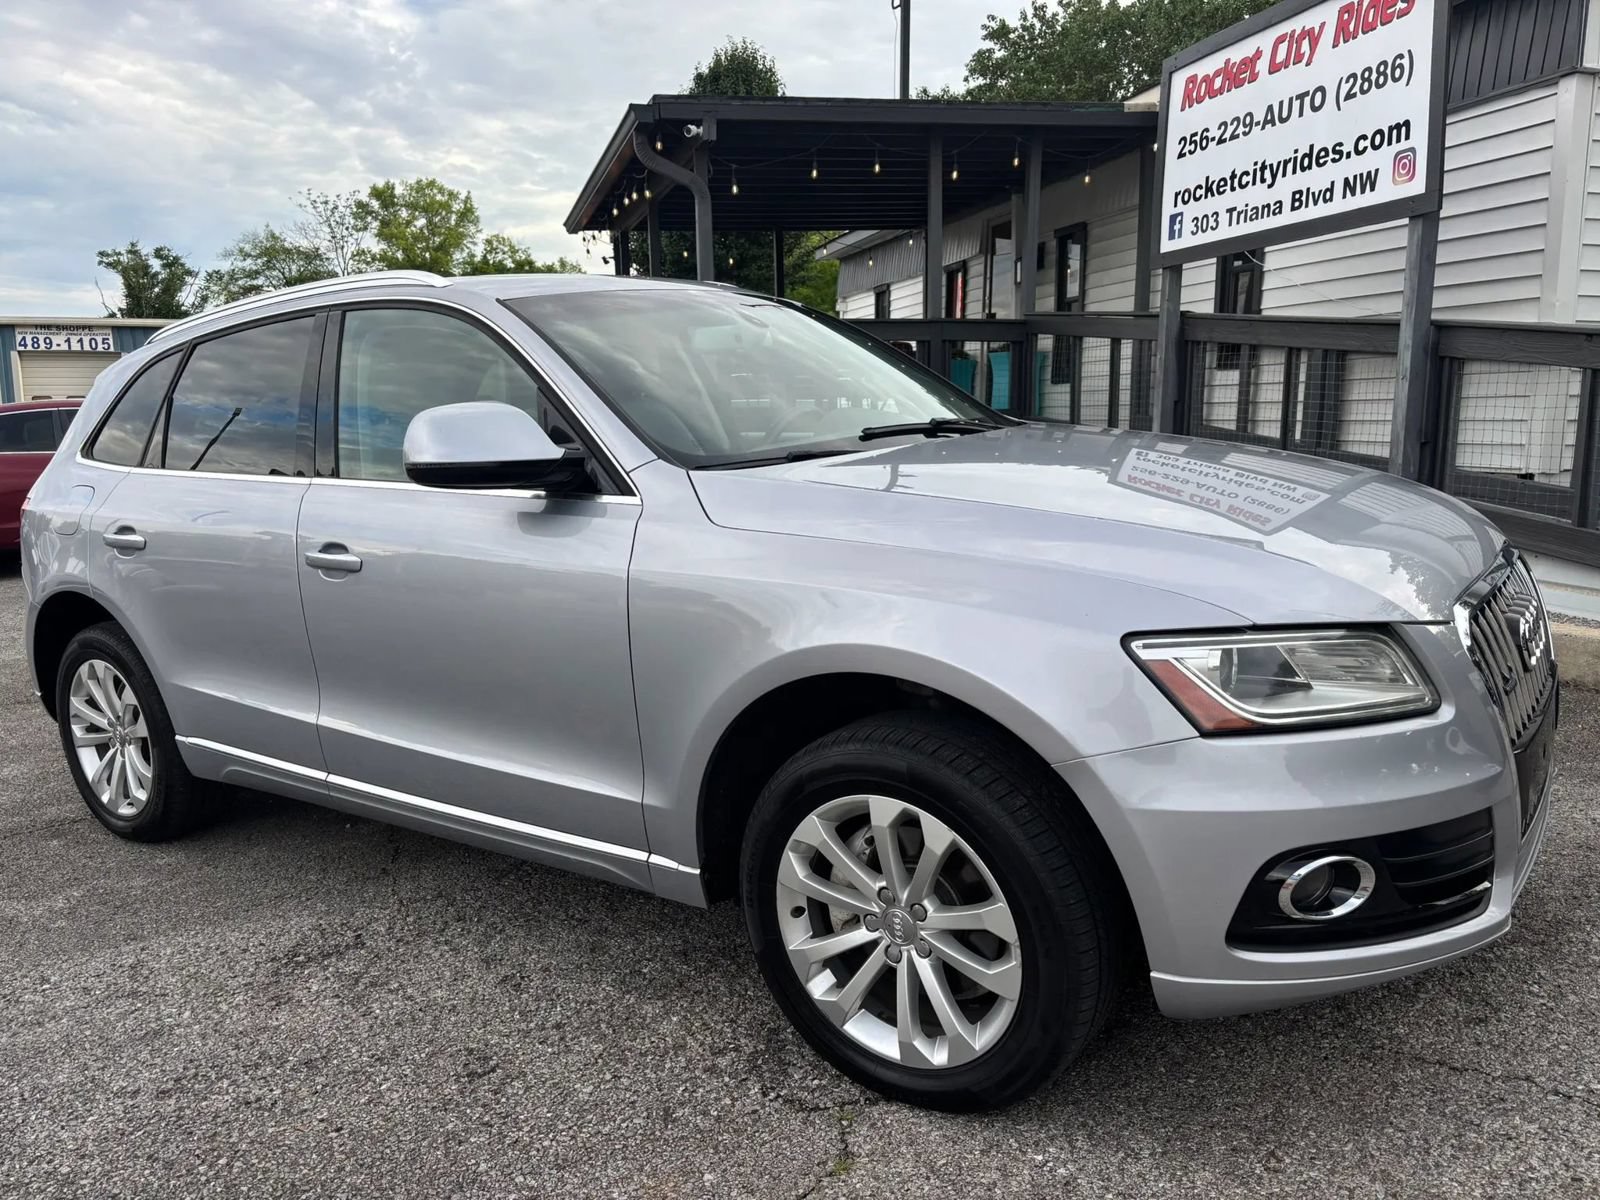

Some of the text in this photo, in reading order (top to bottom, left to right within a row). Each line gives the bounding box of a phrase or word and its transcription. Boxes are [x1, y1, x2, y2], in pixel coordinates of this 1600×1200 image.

[1177, 48, 1415, 160] 256-229-AUTO (2886)
[1180, 46, 1263, 112] Rocket
[1268, 21, 1327, 76] City
[1173, 119, 1412, 208] rocketcityrides.com
[1191, 207, 1220, 236] 303
[1226, 199, 1284, 228] Triana
[1290, 181, 1336, 213] Blvd
[1342, 168, 1380, 200] NW
[18, 336, 111, 351] 489-1105
